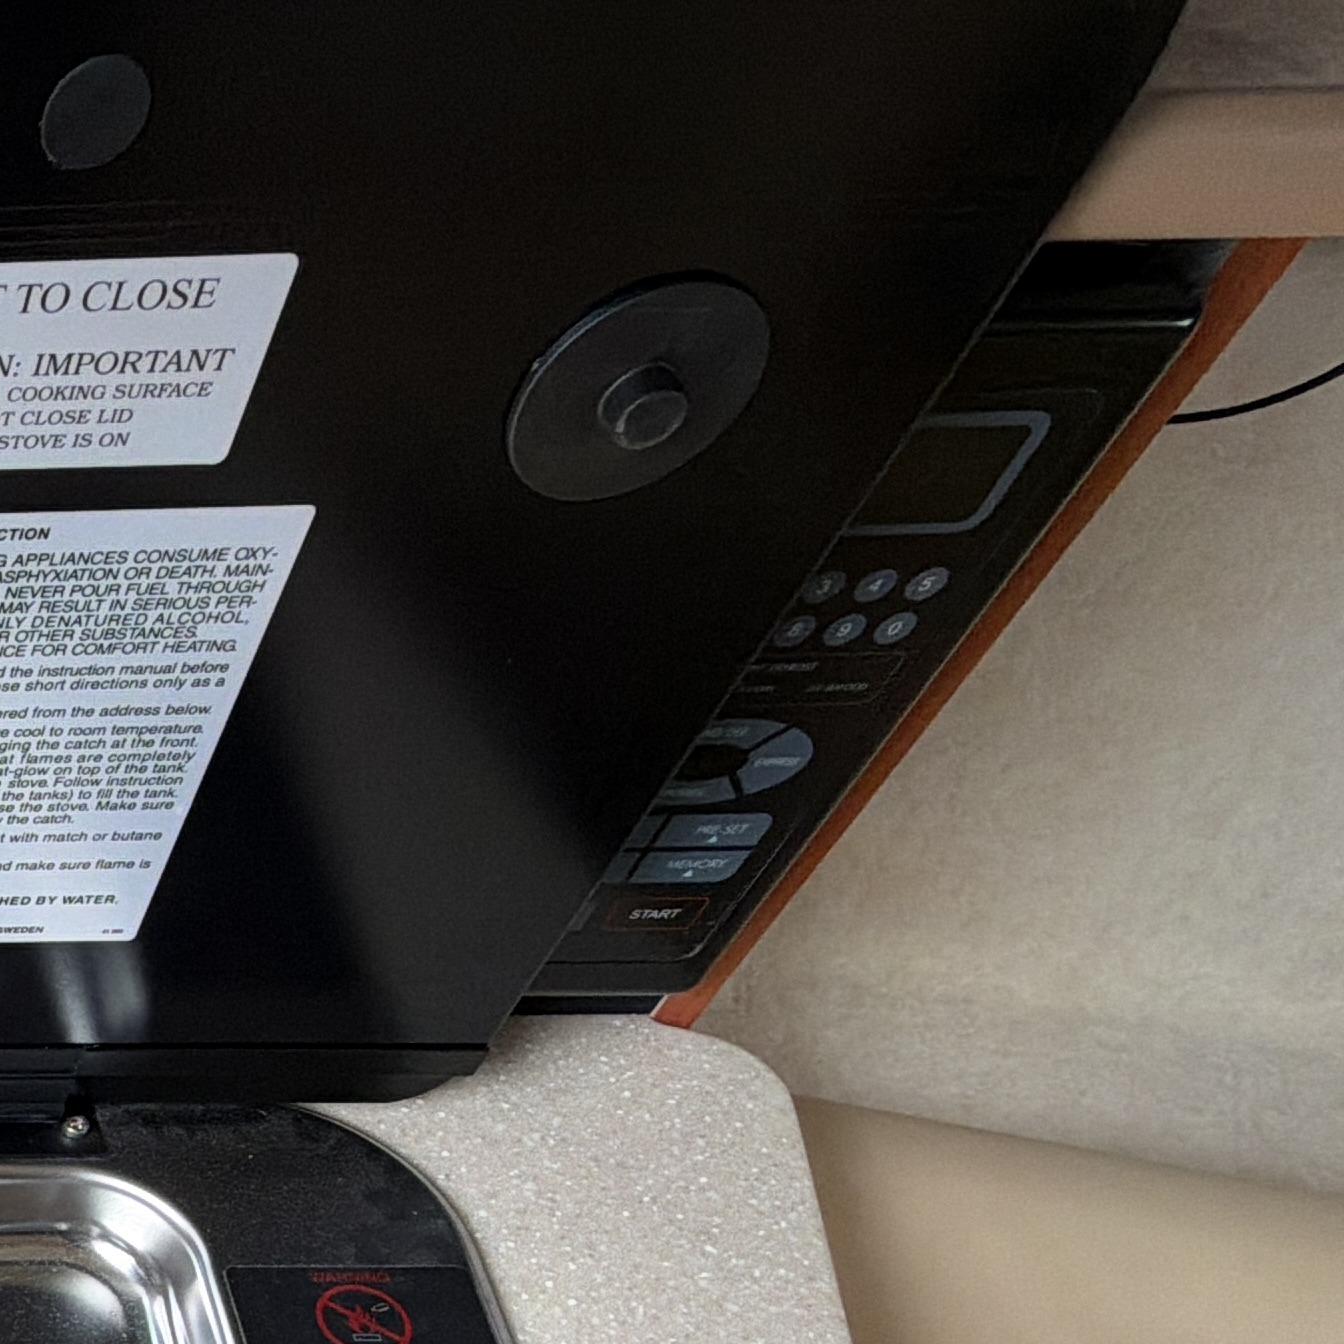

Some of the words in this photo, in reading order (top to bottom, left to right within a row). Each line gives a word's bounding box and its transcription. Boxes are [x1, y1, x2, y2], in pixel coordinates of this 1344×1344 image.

[18, 282, 71, 314] TO
[82, 277, 219, 312] CLOSE
[34, 348, 235, 376] IMPORTANT
[7, 384, 106, 402] COOKING
[112, 381, 213, 399] SURFACE
[20, 409, 91, 426] CLOSE
[96, 408, 134, 424] LID
[71, 432, 93, 448] IS
[98, 431, 131, 447] ON
[12, 550, 128, 567] APPLIANCES
[133, 547, 229, 564] CONSUME
[234, 546, 278, 561] OXY-
[123, 566, 152, 581] OR
[155, 564, 216, 580] DEATH.
[222, 563, 273, 577] MAIN-
[4, 584, 66, 599] NEVER
[68, 583, 121, 598] POUR
[124, 581, 169, 596] FUEL
[177, 579, 266, 594] THROUGH
[38, 598, 105, 614] RESULT
[108, 598, 128, 612] IN
[131, 596, 211, 611] SERIOUS
[214, 594, 257, 609] PER-
[31, 612, 148, 629] DENATURED
[14, 628, 75, 643] OTHER
[30, 643, 68, 657] FOR
[71, 640, 159, 656] COMFORT
[668, 859, 729, 868] MEMORY
[35, 895, 57, 905] BY
[629, 909, 683, 920] START
